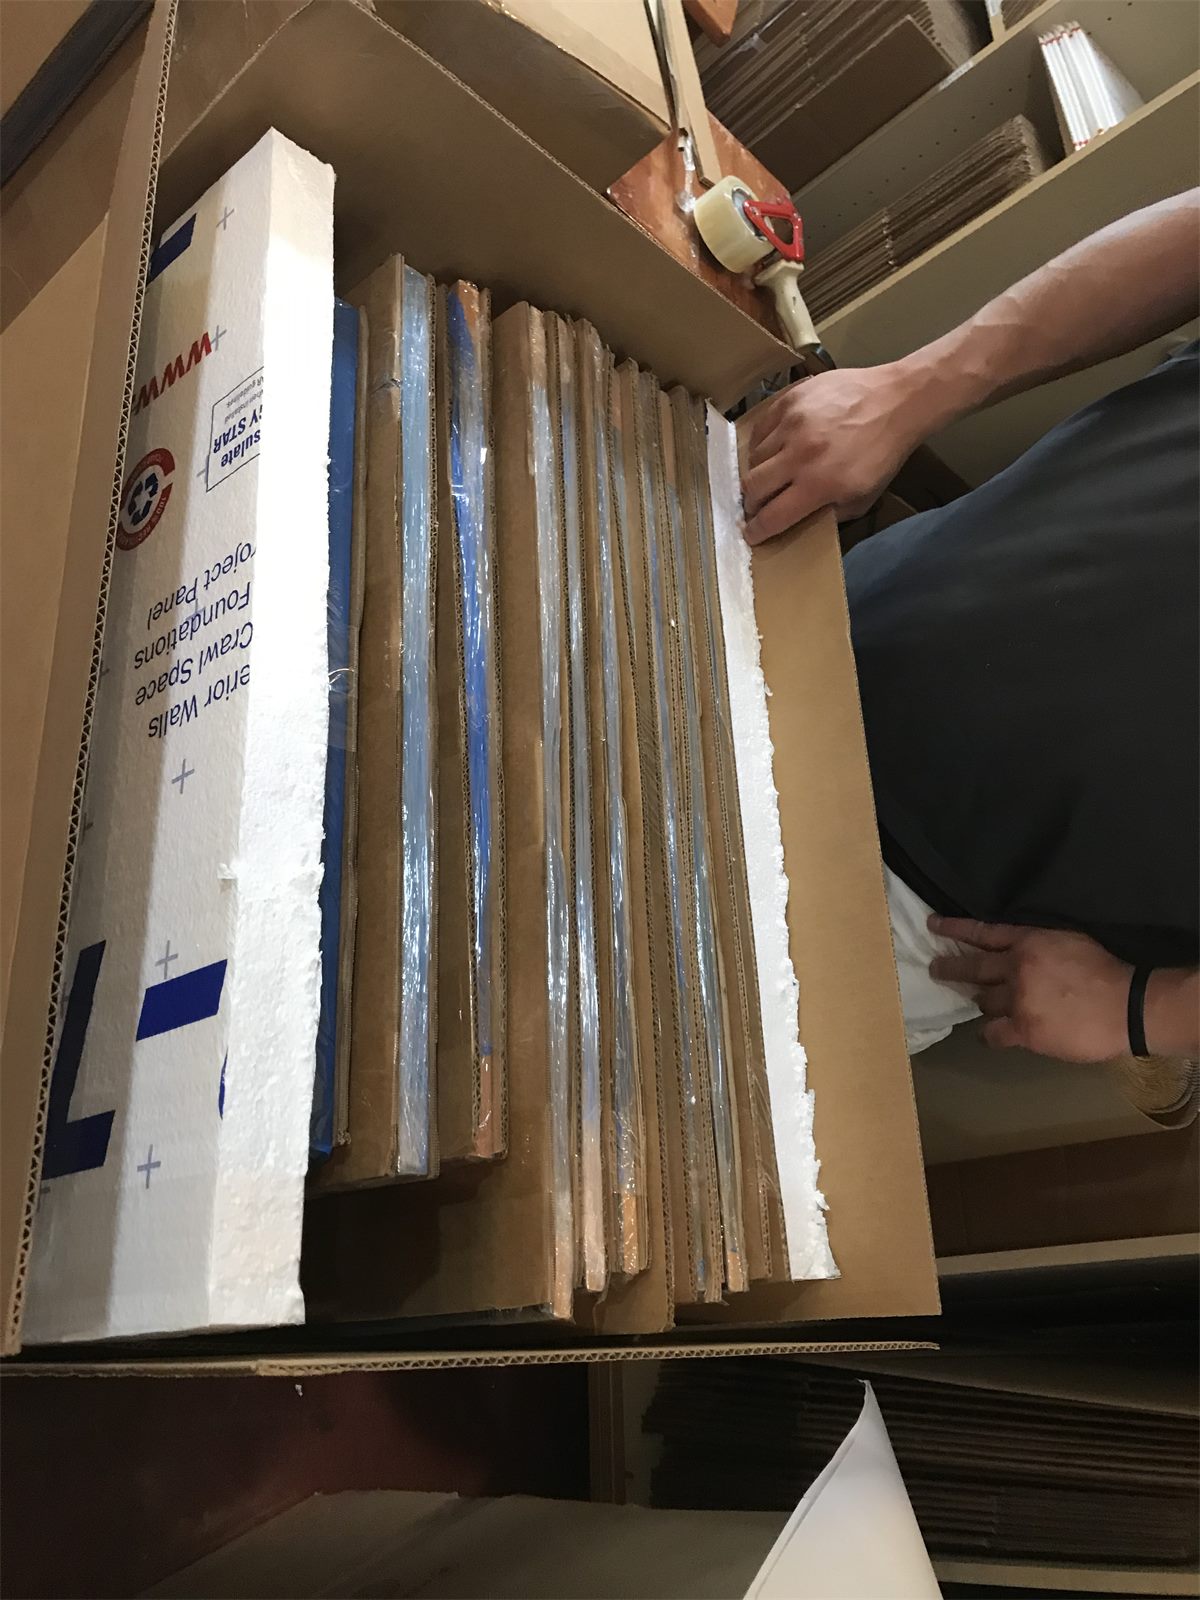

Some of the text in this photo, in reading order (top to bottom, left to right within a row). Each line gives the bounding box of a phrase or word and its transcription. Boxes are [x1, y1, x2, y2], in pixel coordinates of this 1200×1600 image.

[213, 417, 246, 453] STAR
[221, 430, 260, 467] sulate
[134, 582, 251, 669] Foundations
[147, 577, 198, 629] Panel
[135, 622, 254, 705] Crawl Space
[148, 695, 198, 738] Walls
